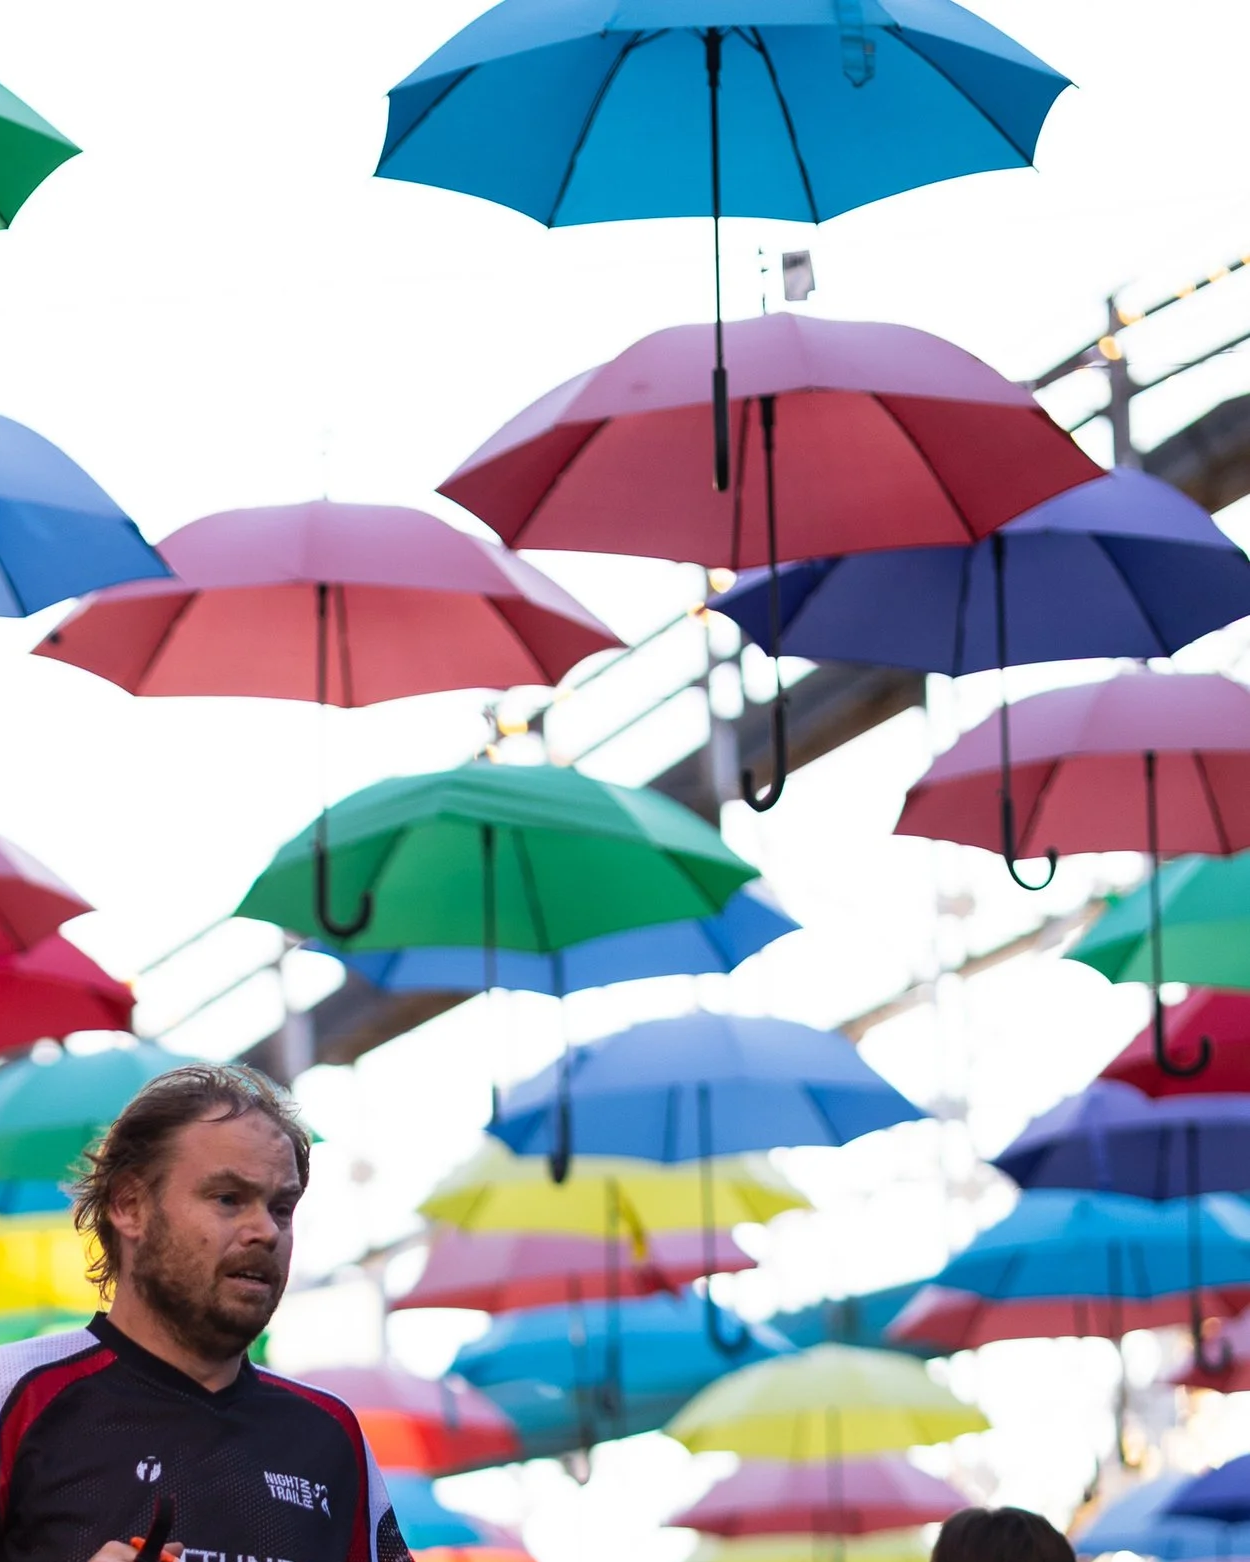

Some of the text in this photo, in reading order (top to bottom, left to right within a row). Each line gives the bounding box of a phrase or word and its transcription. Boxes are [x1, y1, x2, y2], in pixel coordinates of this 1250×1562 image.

[263, 1471, 299, 1490] NIGHT
[268, 1484, 303, 1506] TRAIL
[300, 1478, 314, 1510] RUN
